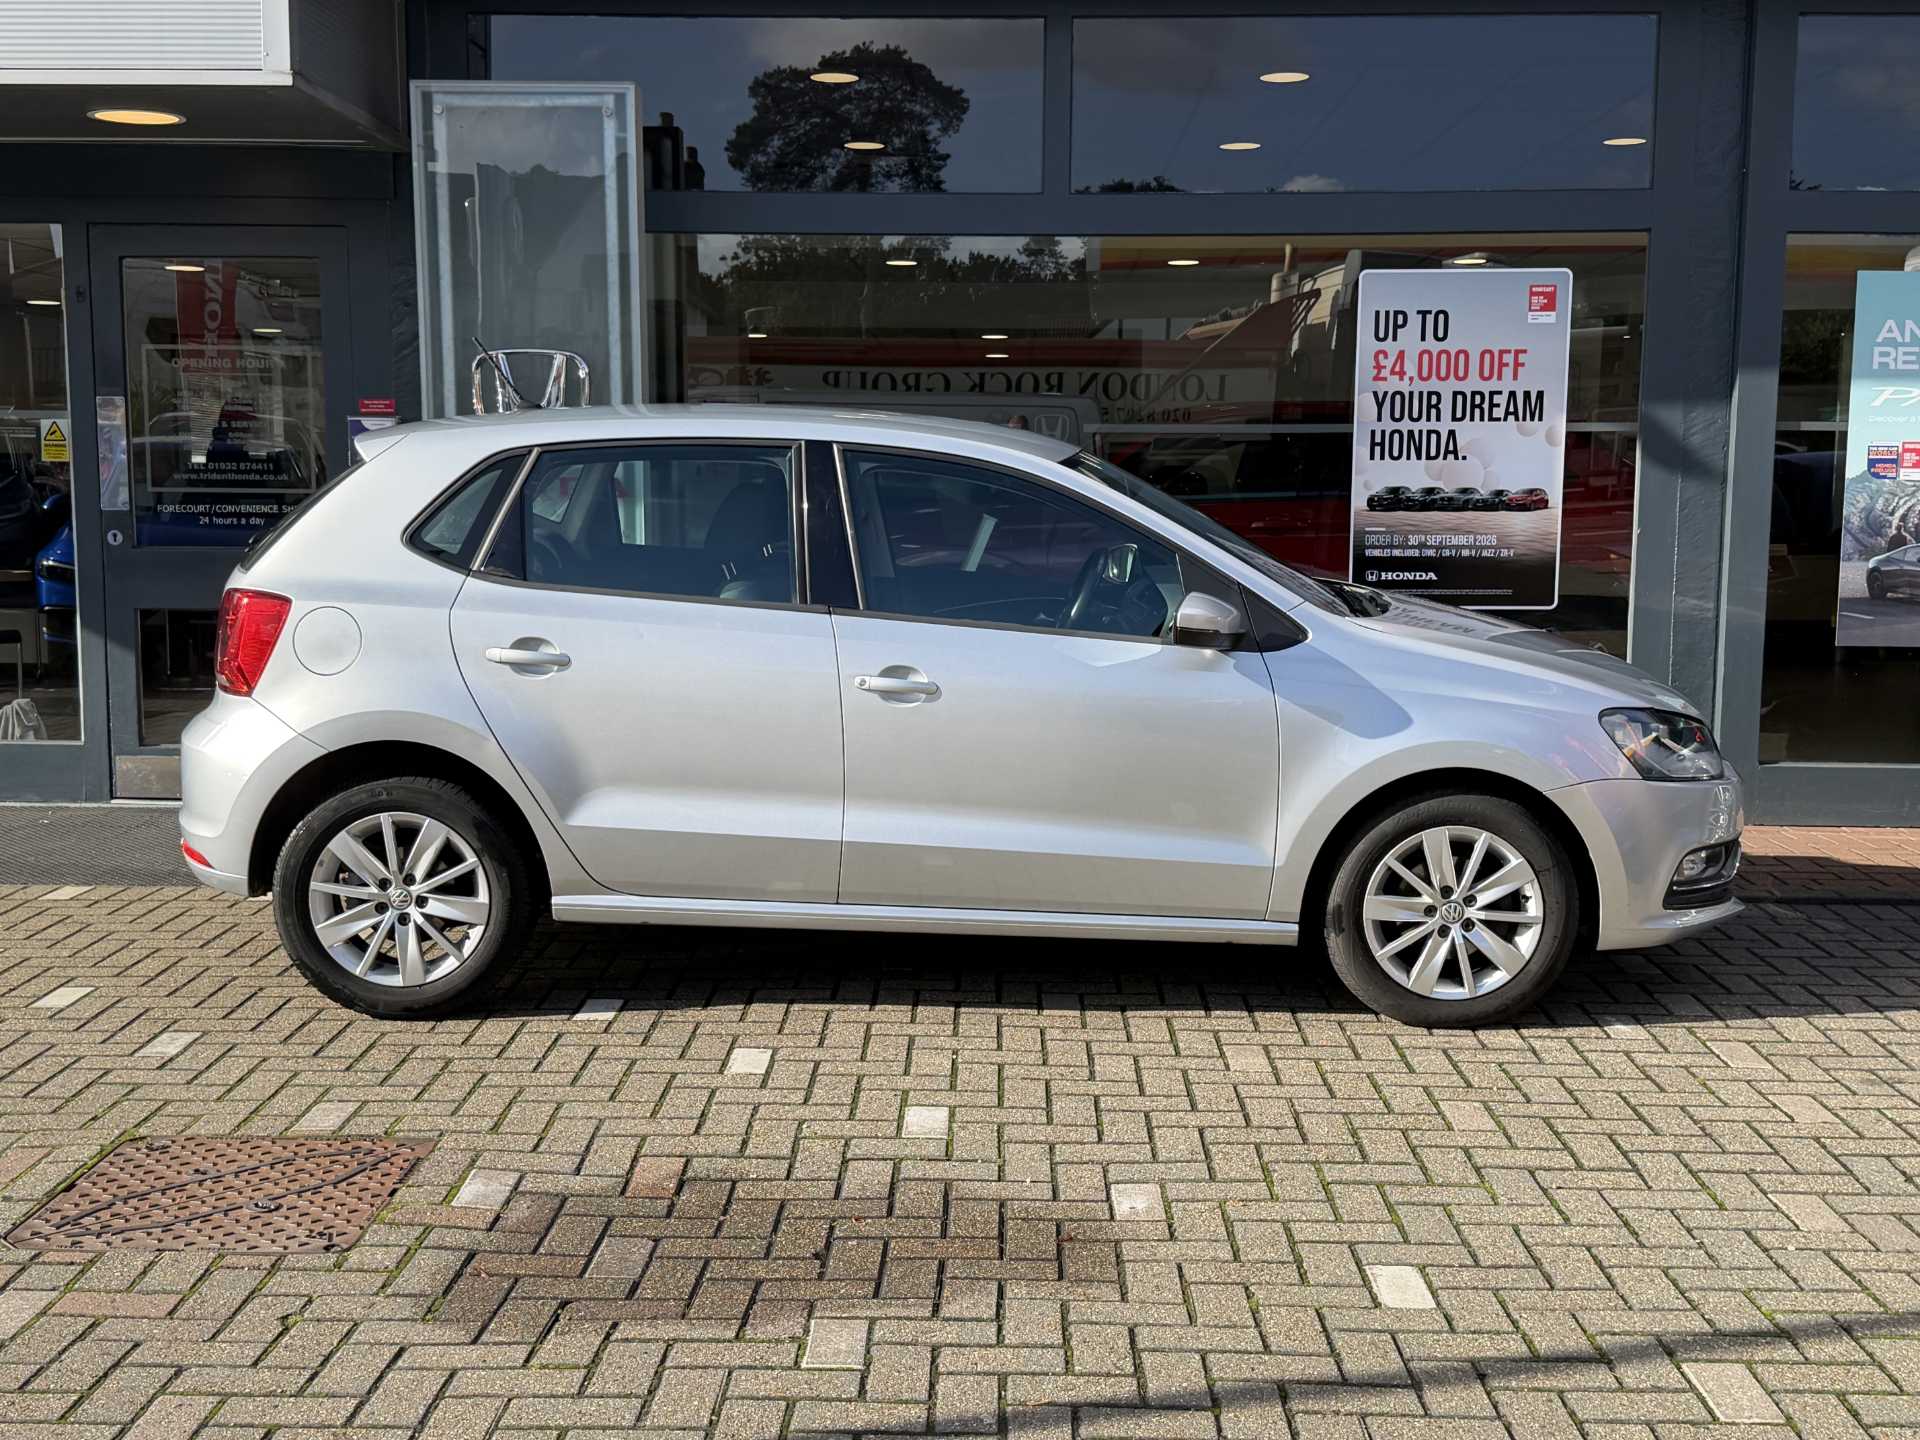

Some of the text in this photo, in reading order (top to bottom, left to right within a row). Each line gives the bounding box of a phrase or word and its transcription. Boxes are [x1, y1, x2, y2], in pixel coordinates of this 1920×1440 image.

[1374, 309, 1449, 342] UP TO
[171, 358, 232, 369] OPENING
[1372, 348, 1528, 386] £4,000 OFF
[1372, 390, 1545, 423] YOUR DREAM
[1369, 429, 1467, 461] HONDA.
[187, 462, 204, 471] TEL
[281, 504, 298, 513] SH
[212, 515, 238, 525] hours
[249, 516, 265, 526] day
[1365, 534, 1391, 546] ORDER
[1393, 534, 1406, 546] BY:
[1426, 534, 1474, 546] SEPTEMBER
[1365, 548, 1391, 557] VEHICLES
[1380, 571, 1438, 581] HONDA
